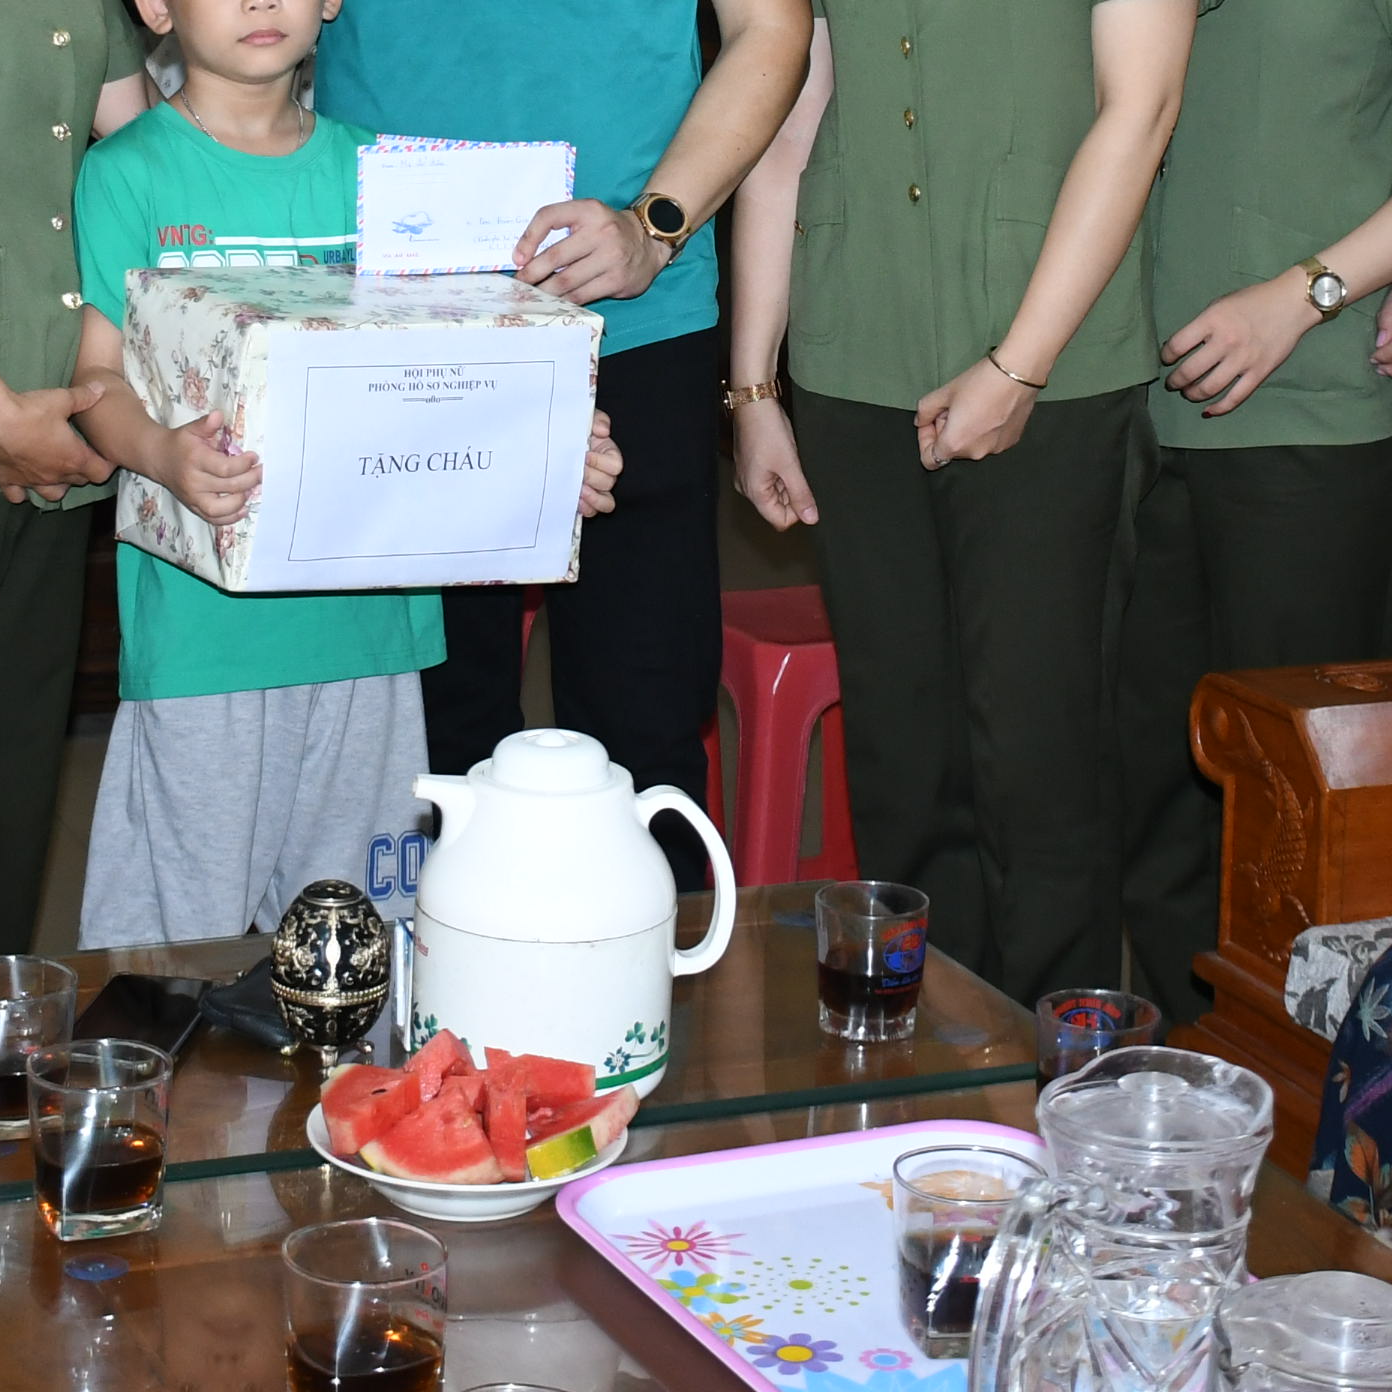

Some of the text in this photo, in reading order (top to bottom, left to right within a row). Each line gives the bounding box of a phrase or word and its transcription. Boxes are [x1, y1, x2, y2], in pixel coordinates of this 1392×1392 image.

[403, 368, 423, 380] HỘI
[426, 367, 447, 380] PHỤ
[368, 381, 406, 393] PHÒNG
[484, 379, 498, 392] VỤ
[359, 445, 494, 479] TẶNG CHÁU
